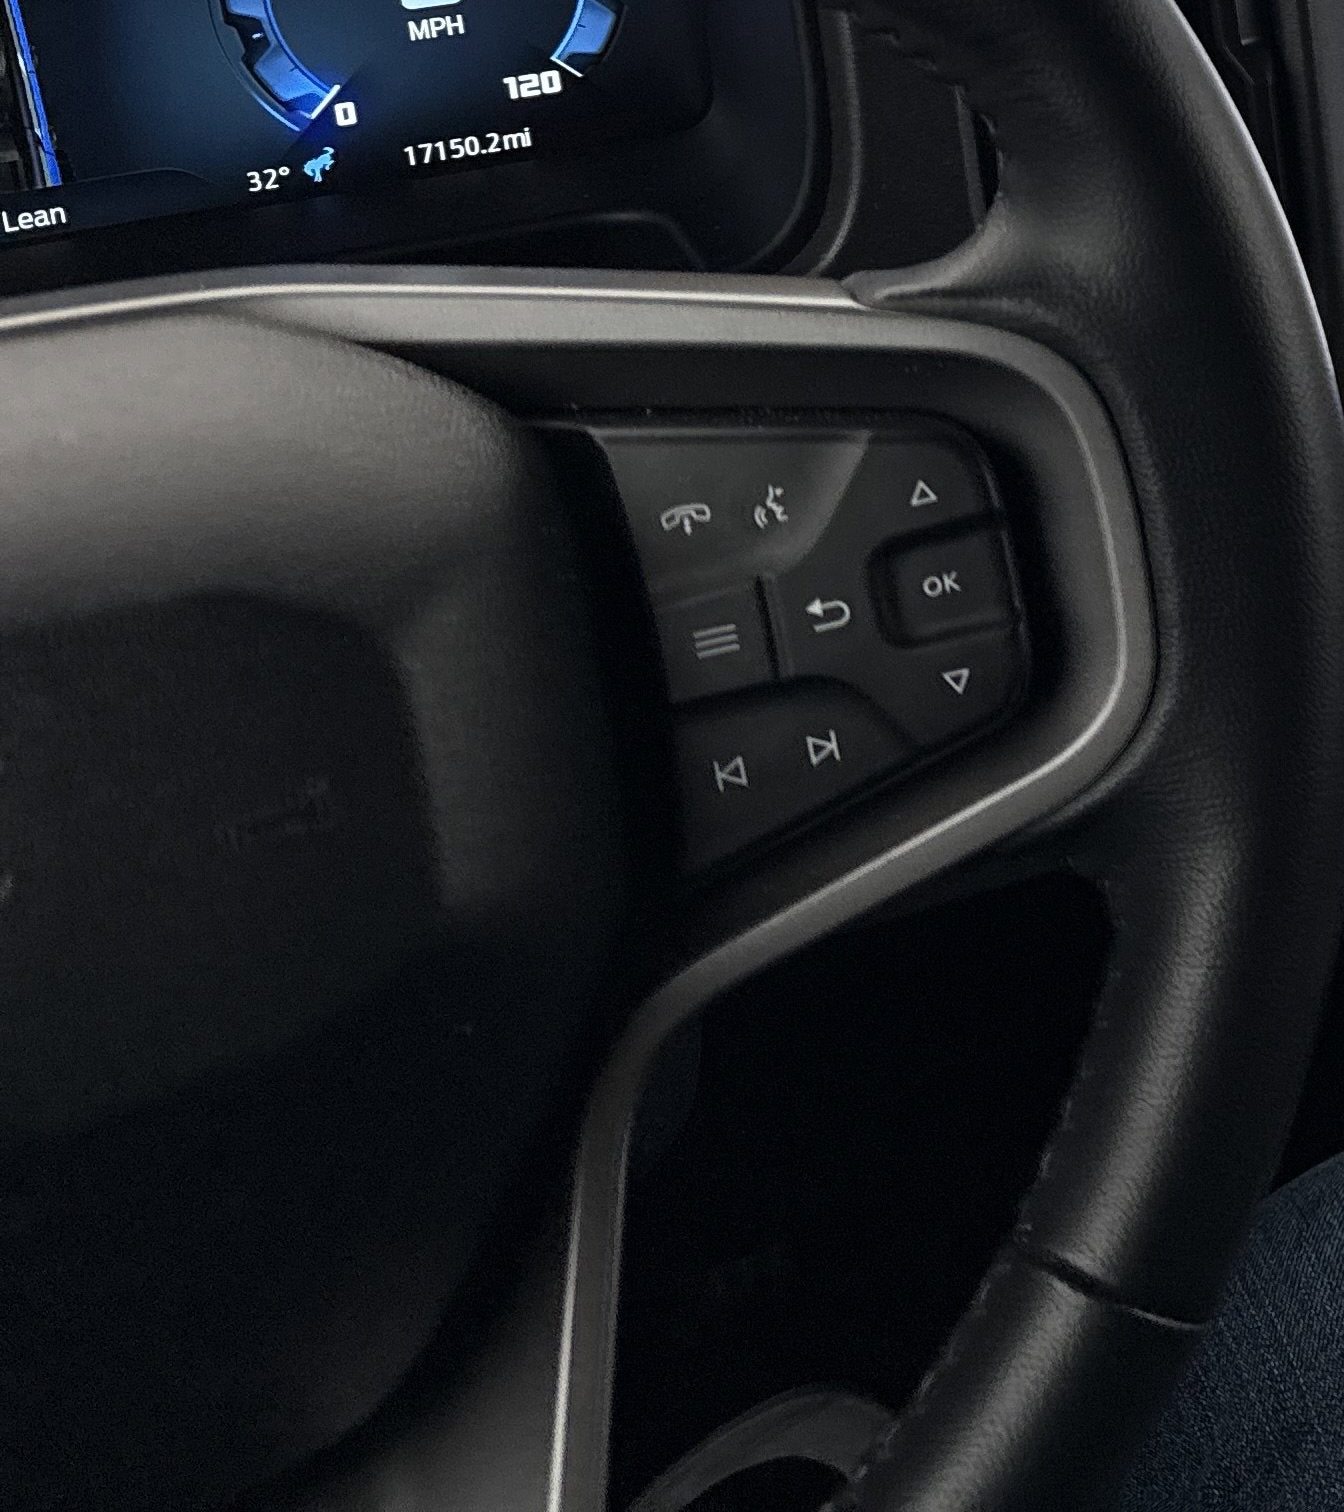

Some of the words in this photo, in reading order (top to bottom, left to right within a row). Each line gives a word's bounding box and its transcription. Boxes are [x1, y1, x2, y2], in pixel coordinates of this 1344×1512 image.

[407, 14, 466, 42] MPH
[502, 69, 563, 101] 120
[335, 100, 358, 128] 0
[1, 204, 67, 233] Lean
[922, 571, 962, 598] OK
